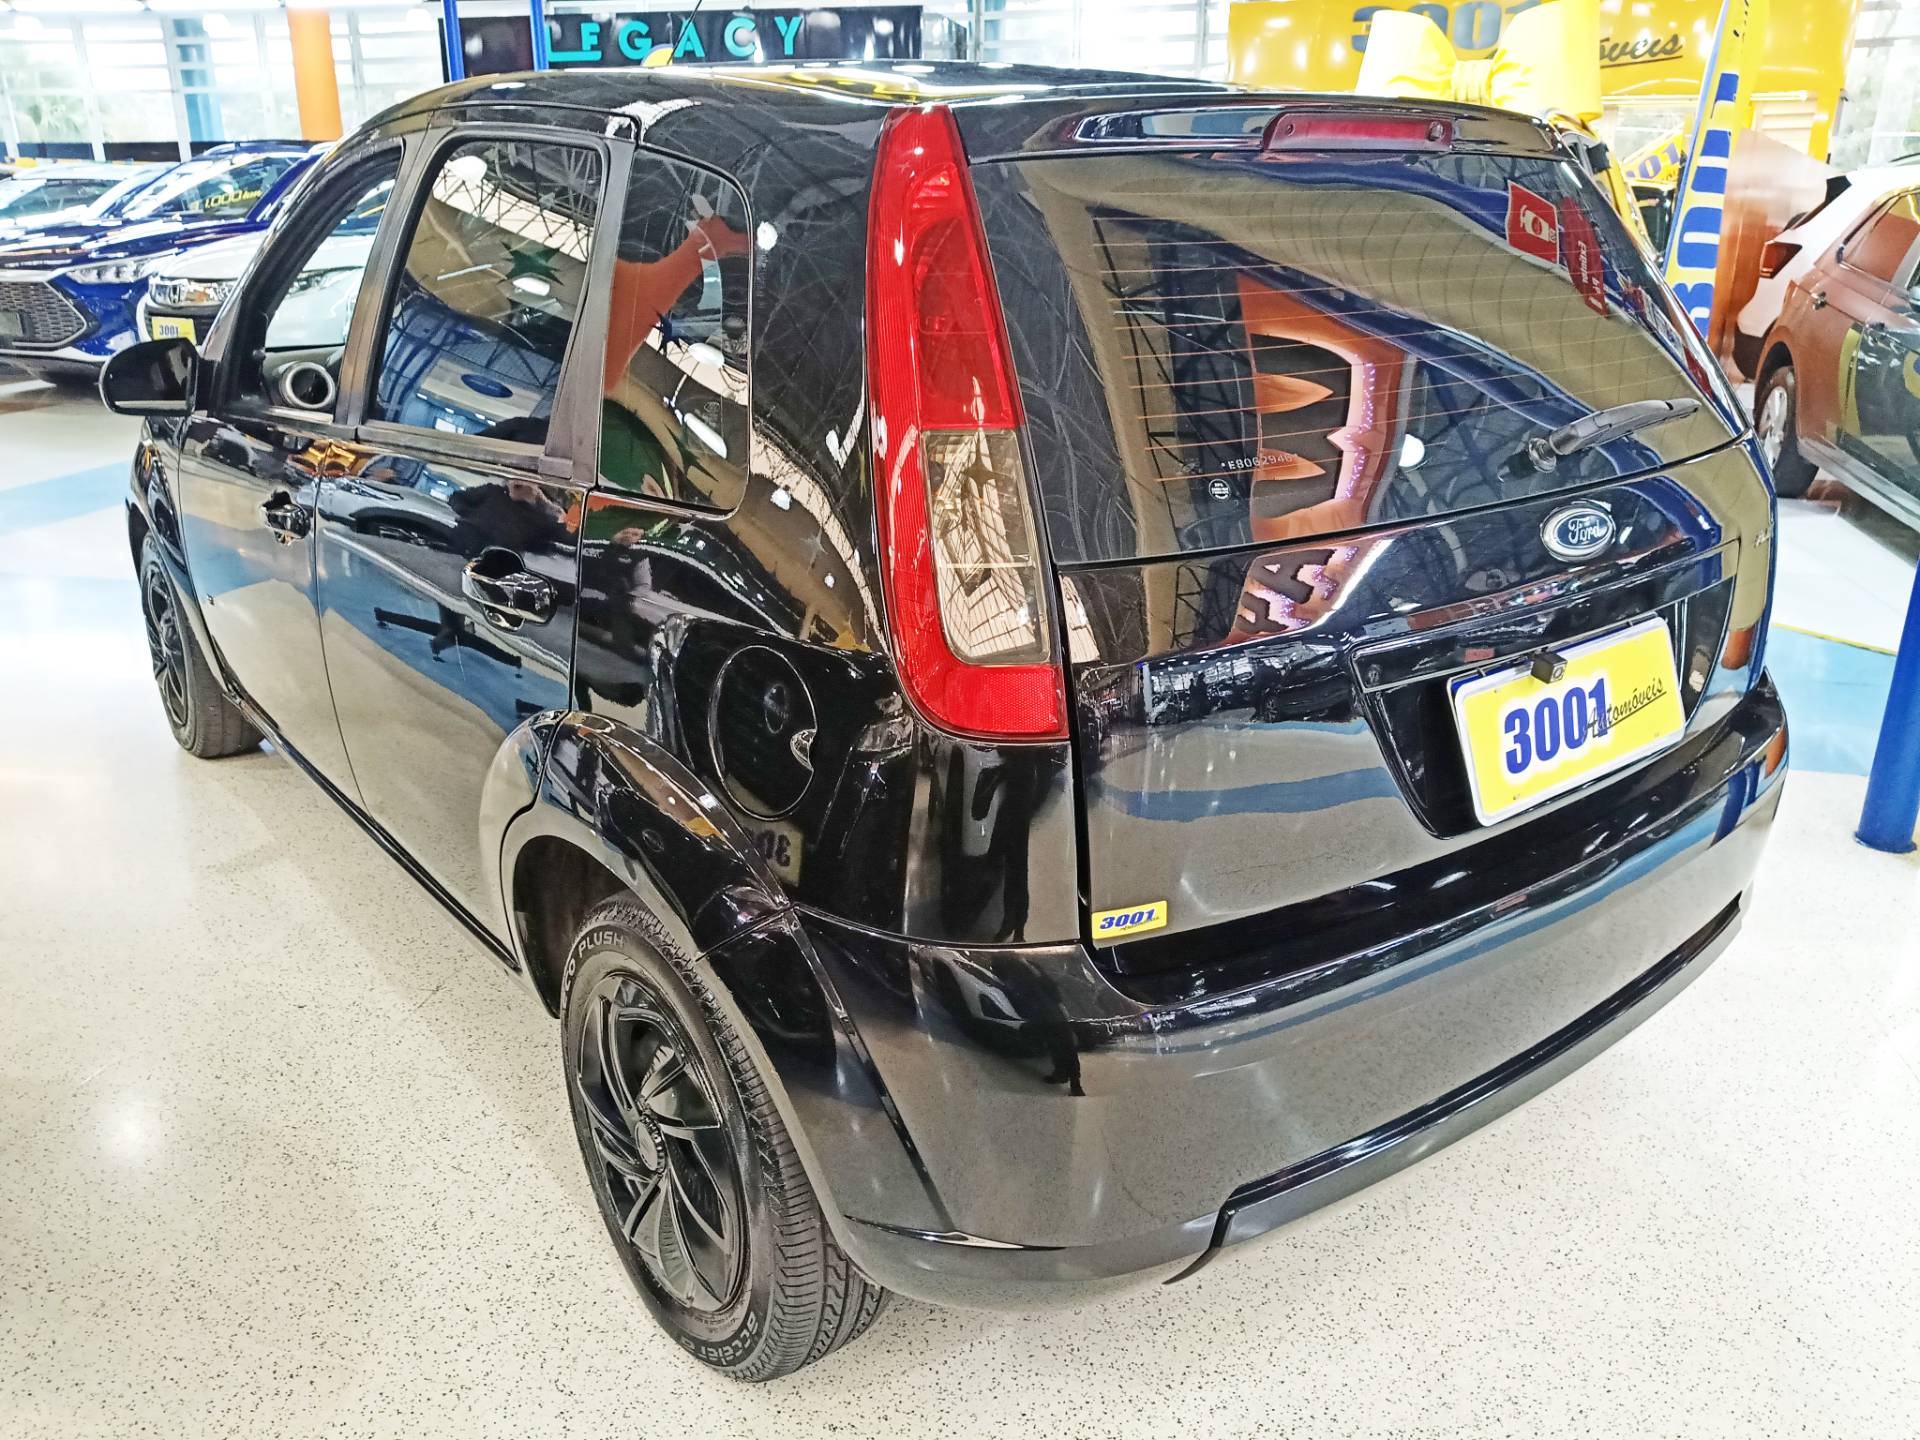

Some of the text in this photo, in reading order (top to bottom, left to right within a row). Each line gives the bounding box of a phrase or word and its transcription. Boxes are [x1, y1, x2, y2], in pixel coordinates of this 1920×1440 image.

[547, 16, 801, 62] LEGACY
[1568, 518, 1606, 544] Ford
[1504, 678, 1608, 775] 3001
[1100, 909, 1155, 930] 3001
[578, 931, 625, 958] PLUSH
